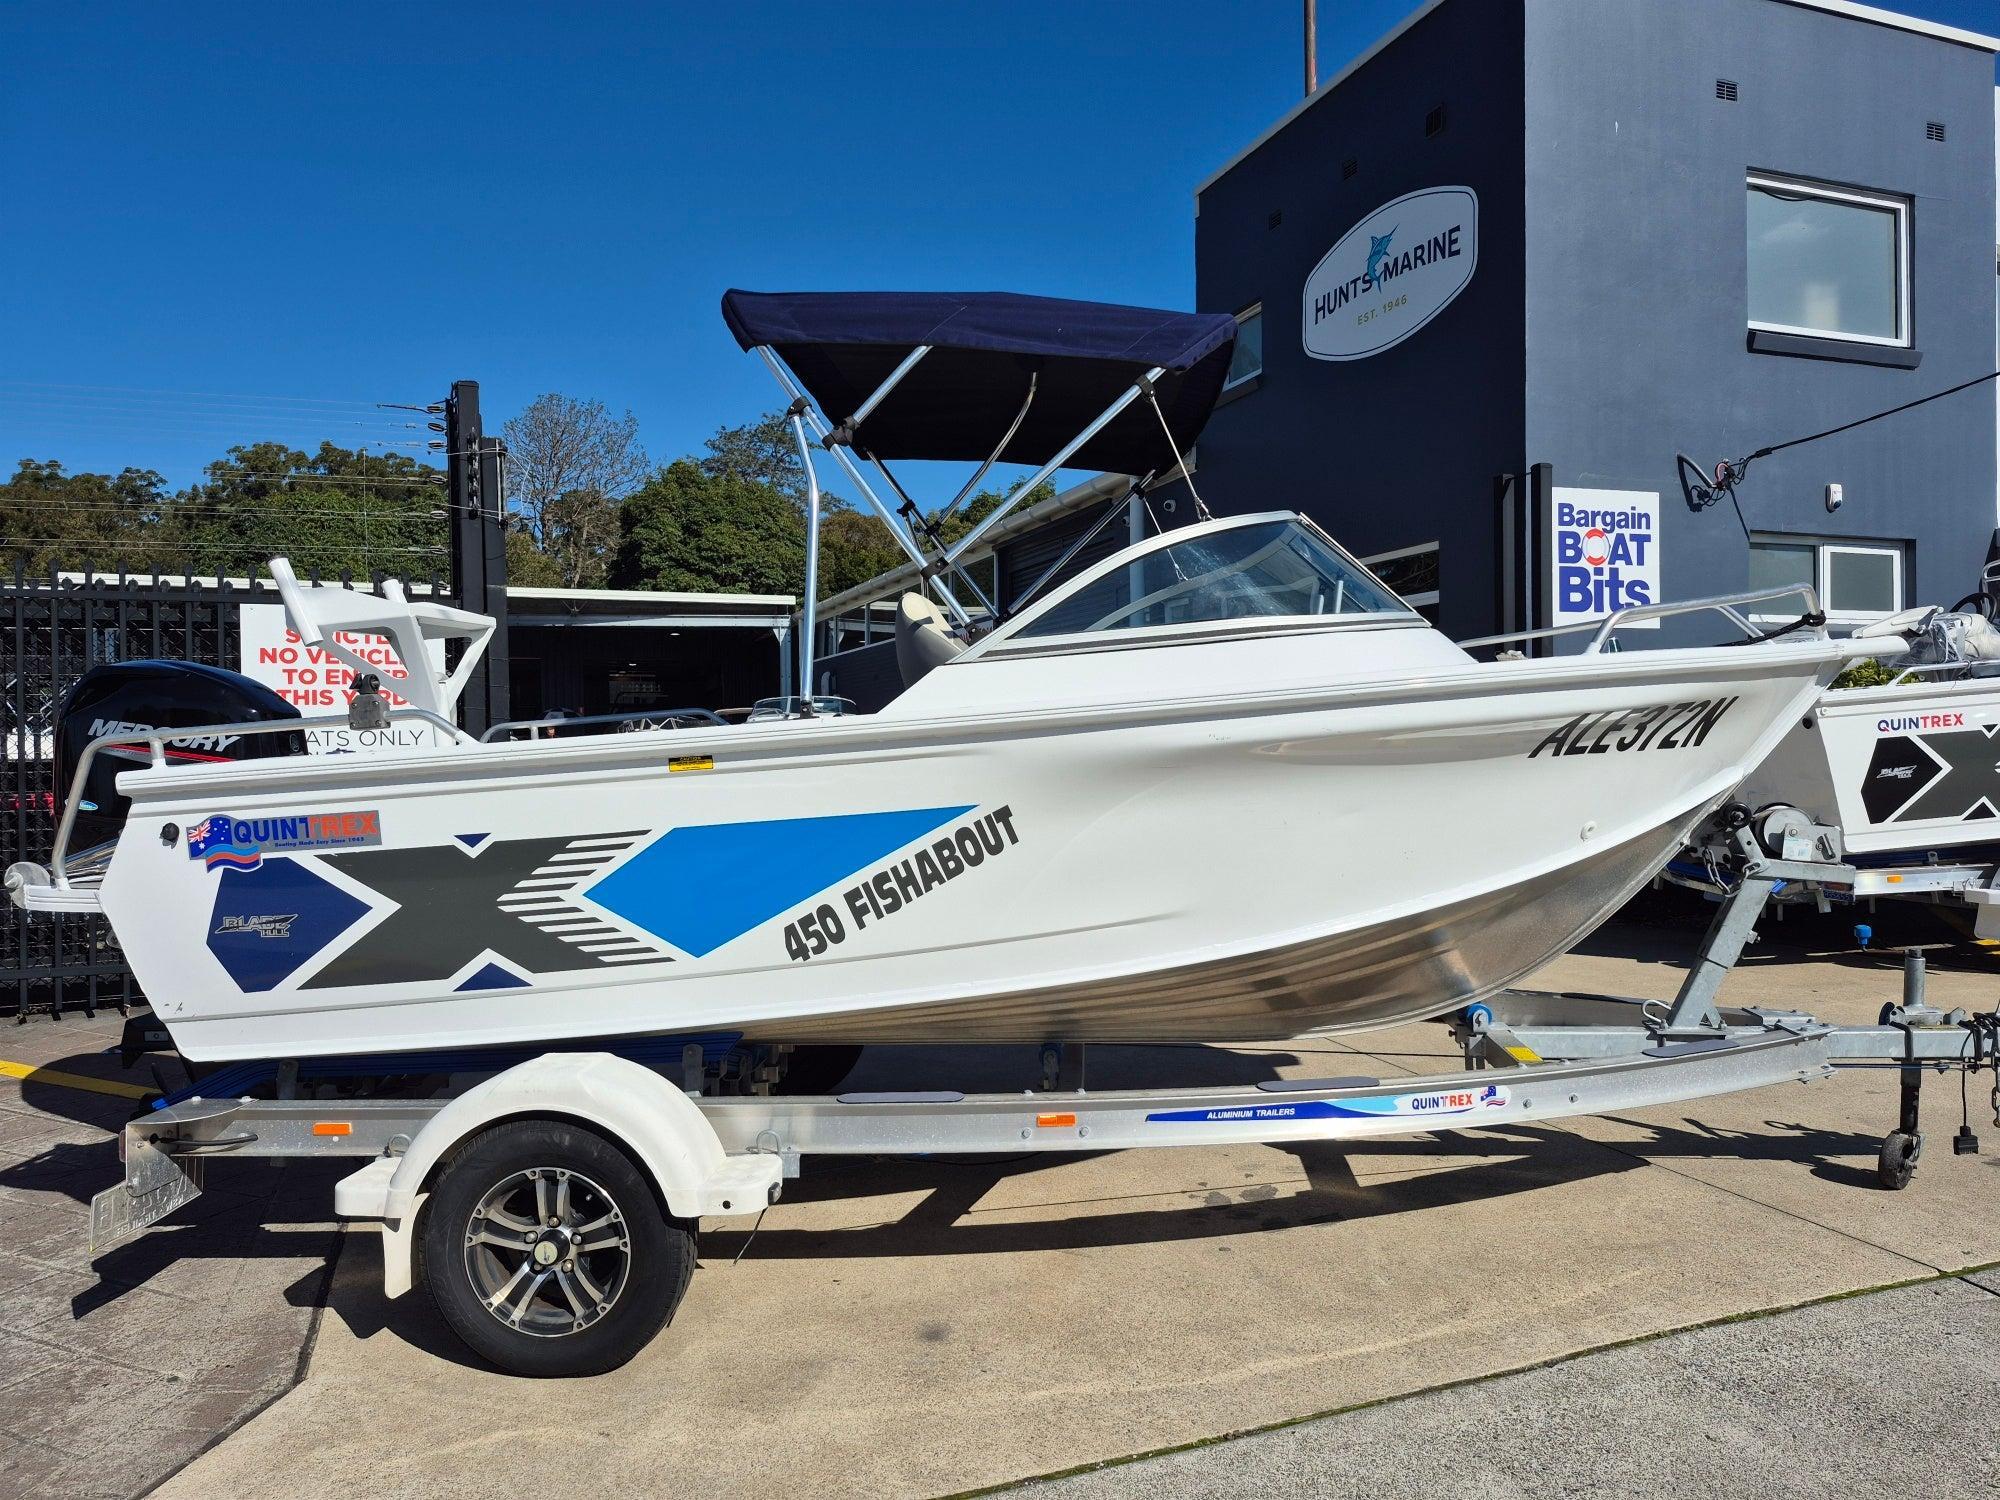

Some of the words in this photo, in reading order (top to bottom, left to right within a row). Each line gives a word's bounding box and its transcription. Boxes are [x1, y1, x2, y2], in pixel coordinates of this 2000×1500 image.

[1315, 272, 1373, 325] HUNTS
[1383, 225, 1461, 282] MARINE
[1357, 309, 1378, 326] EST.
[1382, 294, 1408, 313] 1946
[1558, 502, 1651, 534] Bargain
[1558, 566, 1651, 613] Bits
[259, 648, 299, 665] NO
[282, 668, 318, 686] TO
[275, 689, 335, 707] THIS
[1527, 695, 1740, 759] ALE372N
[1877, 713, 1964, 733] QUINTREX
[358, 730, 425, 747] ONLY
[233, 812, 379, 844] QUINTREX
[783, 903, 846, 962] 450
[842, 804, 1020, 931] FISHABOUT
[1206, 1109, 1253, 1120] ALUMINIUM
[1256, 1107, 1296, 1117] TRAILERS
[1411, 1093, 1473, 1111] QUINTREX
